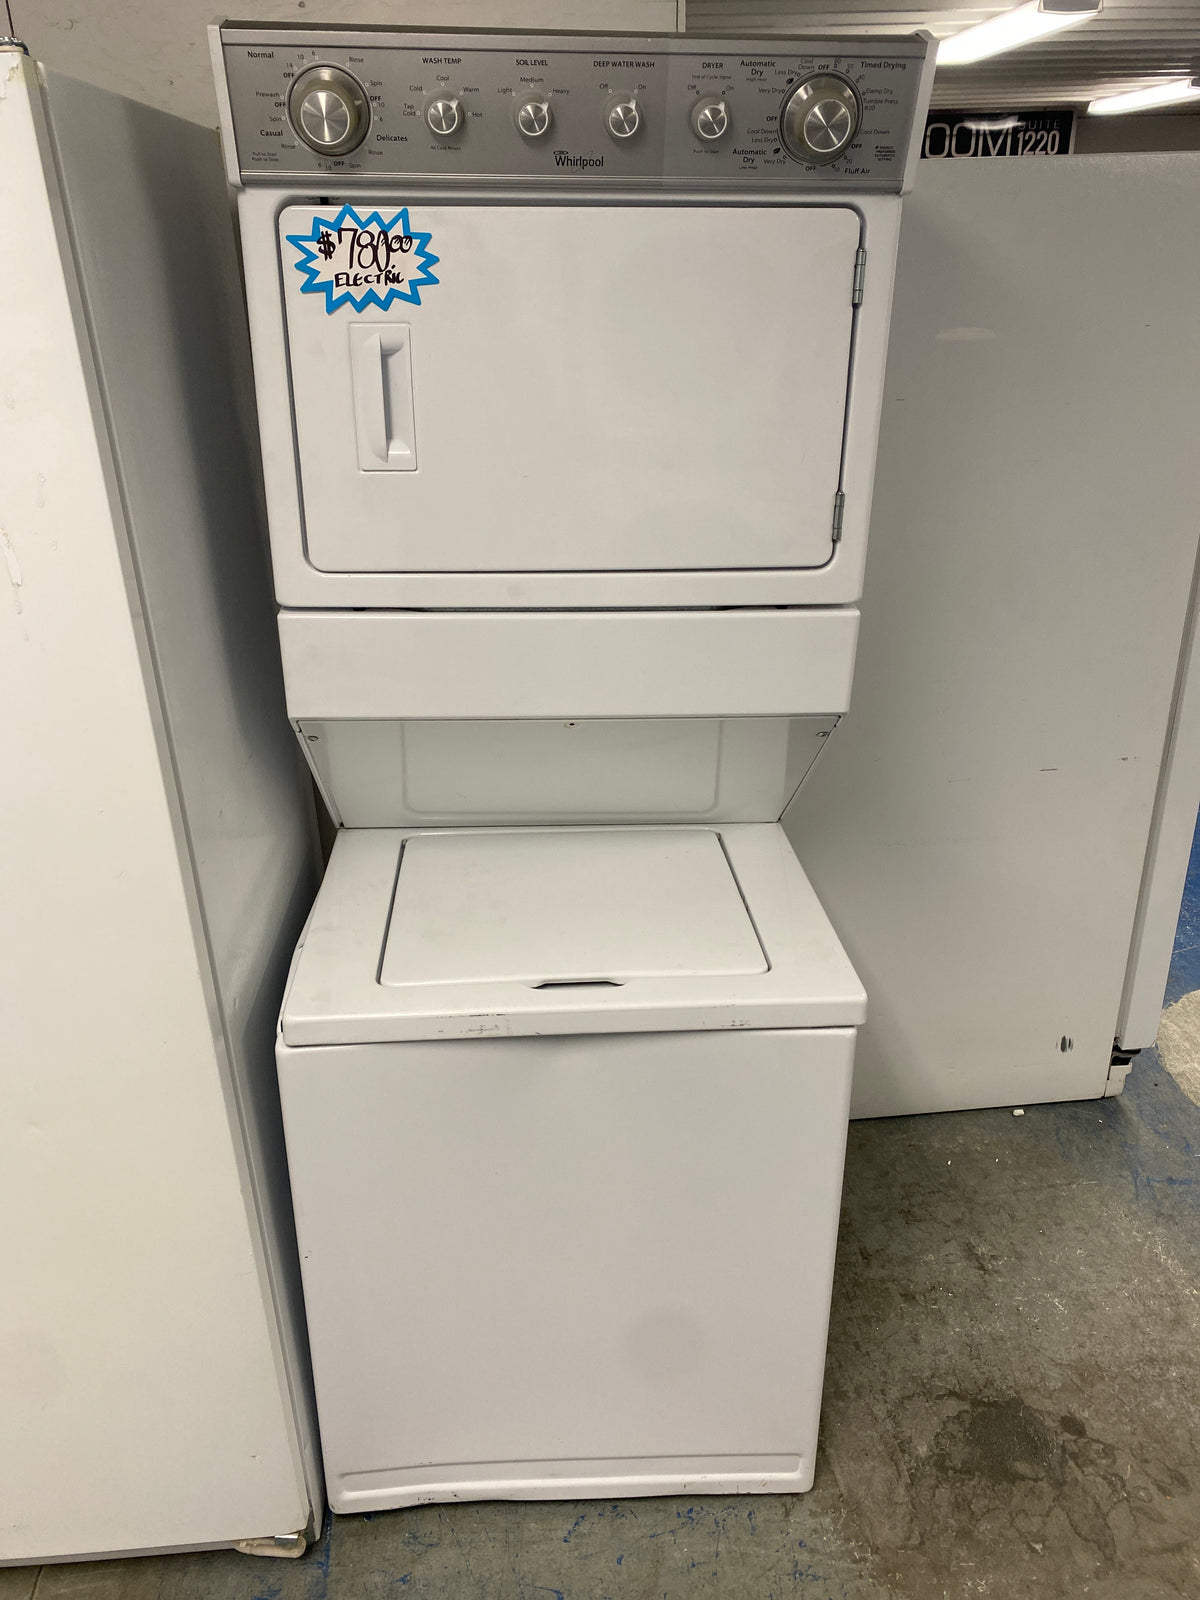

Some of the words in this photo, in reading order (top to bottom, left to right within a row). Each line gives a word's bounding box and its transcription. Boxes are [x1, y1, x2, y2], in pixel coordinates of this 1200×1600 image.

[247, 51, 274, 59] Normal
[740, 60, 776, 68] Automatic
[861, 61, 882, 69] Timed
[883, 62, 906, 70] Drying
[751, 69, 764, 77] Dry
[1018, 119, 1061, 130] SUITE
[260, 129, 283, 137] Casual
[376, 134, 408, 142] Delicates
[1017, 130, 1060, 156] 1220
[732, 148, 767, 156] Automatic
[554, 155, 604, 170] Whirlpool
[743, 156, 755, 164] Dry
[844, 167, 860, 175] Fluff
